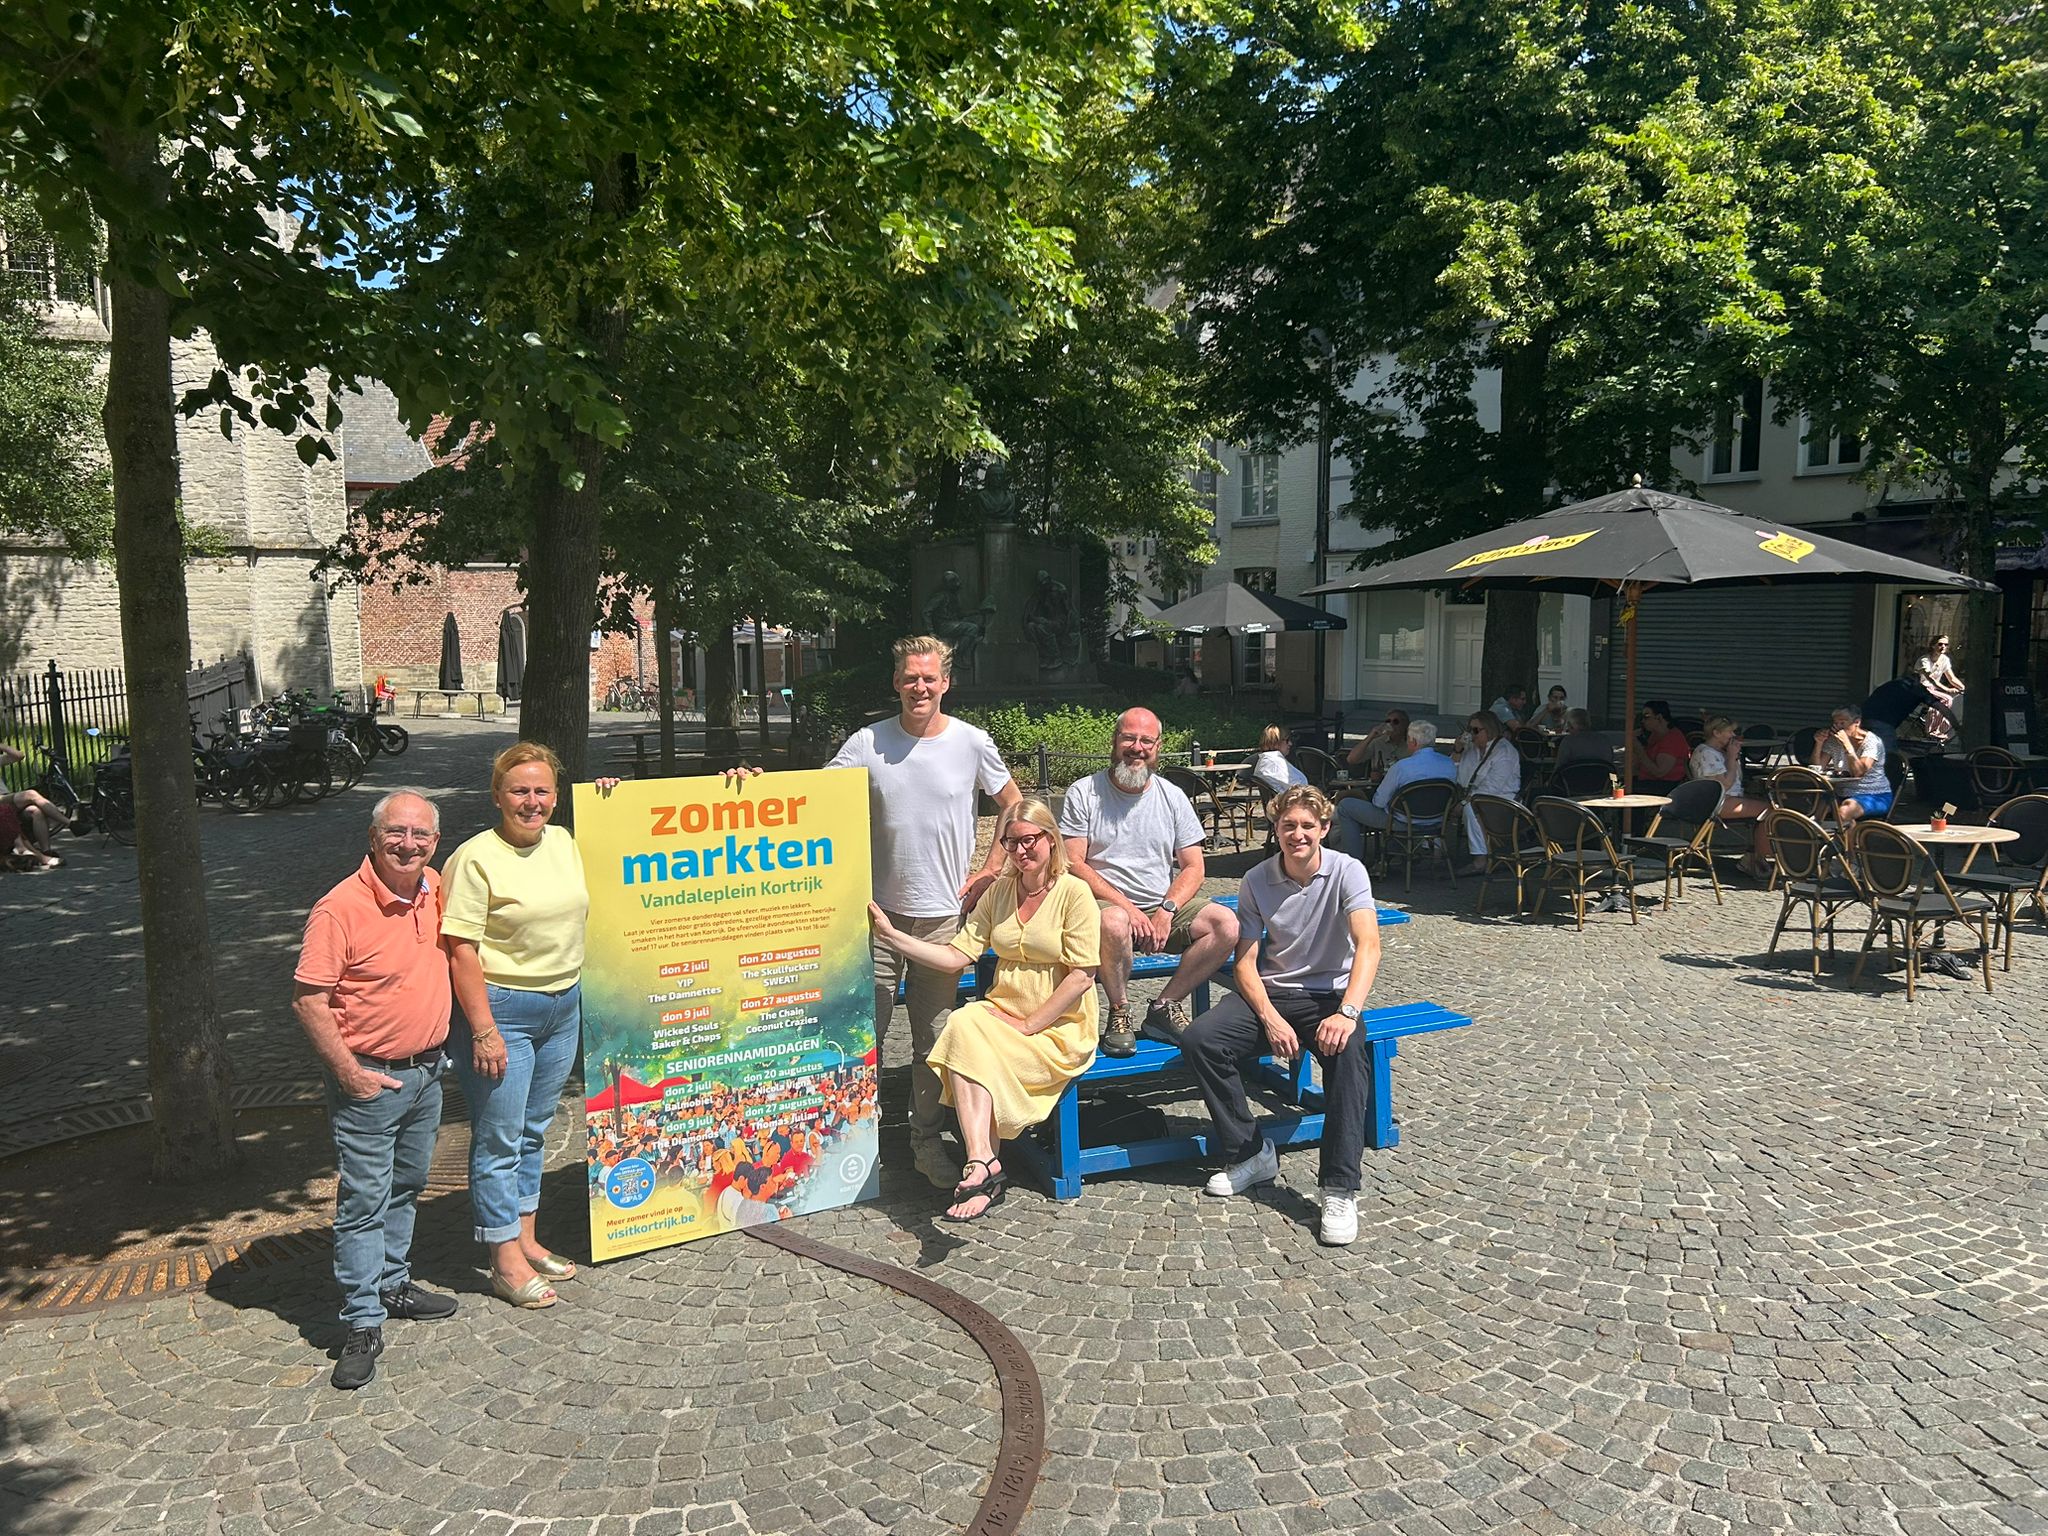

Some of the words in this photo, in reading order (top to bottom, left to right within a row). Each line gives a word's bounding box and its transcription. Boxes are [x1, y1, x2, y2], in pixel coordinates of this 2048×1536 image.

[650, 796, 807, 836] zomer
[622, 835, 833, 885] markten
[640, 885, 756, 909] Vandaleplein
[760, 876, 823, 898] Kortrijk
[623, 929, 639, 937] Laat
[645, 926, 677, 934] verrassen
[692, 922, 712, 930] gratis
[772, 910, 804, 919] momenten
[811, 906, 837, 914] heerlijke
[692, 911, 732, 921] donderdagen
[630, 936, 657, 945] smaken
[675, 931, 690, 939] hart
[736, 922, 767, 931] sfeervolle
[766, 918, 809, 928] avondmarkten
[808, 915, 831, 923] starten
[630, 944, 650, 953] vanaf
[680, 934, 744, 946] seniorennamiddagen
[764, 928, 784, 937] plaats
[739, 954, 759, 965] don
[760, 951, 774, 962] 20
[775, 947, 820, 960] augustus
[660, 965, 681, 976] don
[682, 962, 690, 973] 2
[691, 959, 708, 973] juli
[742, 970, 760, 979] The
[761, 962, 819, 977] Skullfuckers
[677, 978, 694, 988] YIP
[763, 974, 799, 987] SWEAT!
[648, 993, 667, 1004] The
[668, 986, 722, 1001] Damnettes
[741, 998, 761, 1010] don
[762, 995, 775, 1006] 27
[775, 990, 821, 1004] augustus
[662, 1013, 683, 1023] don
[684, 1009, 692, 1020] 9
[692, 1006, 710, 1020] juli
[760, 1011, 777, 1021] The
[778, 1006, 804, 1018] Chain
[653, 1025, 690, 1040] Wicked
[691, 1021, 719, 1034] Souls
[745, 1021, 784, 1034] Coconut
[784, 1016, 819, 1029] Crazies
[651, 1038, 682, 1051] Baker
[682, 1036, 691, 1046] &
[691, 1032, 722, 1044] Chaps
[666, 1038, 820, 1075] SENIORENNAMIDDAGEN
[743, 1073, 763, 1083] don
[763, 1069, 777, 1079] 20
[778, 1062, 823, 1077] augustus
[664, 1087, 686, 1097] don
[686, 1084, 694, 1093] 2
[694, 1080, 712, 1094] juli
[755, 1083, 785, 1095] Nicola
[664, 1096, 714, 1113] Balmobiel
[745, 1107, 764, 1117] don
[765, 1103, 778, 1113] 27
[778, 1095, 823, 1110] augustus
[666, 1122, 687, 1132] don
[687, 1119, 695, 1129] 9
[695, 1115, 714, 1129] juli
[750, 1118, 790, 1130] Thomas
[790, 1110, 820, 1123] Julian
[651, 1140, 670, 1150] The
[671, 1131, 720, 1146] Diamonds
[606, 1219, 626, 1227] Meer
[626, 1213, 650, 1222] zomer
[649, 1209, 666, 1218] vind
[665, 1208, 674, 1216] je
[673, 1205, 684, 1213] op
[607, 1213, 696, 1241] visitkortrijk.be
